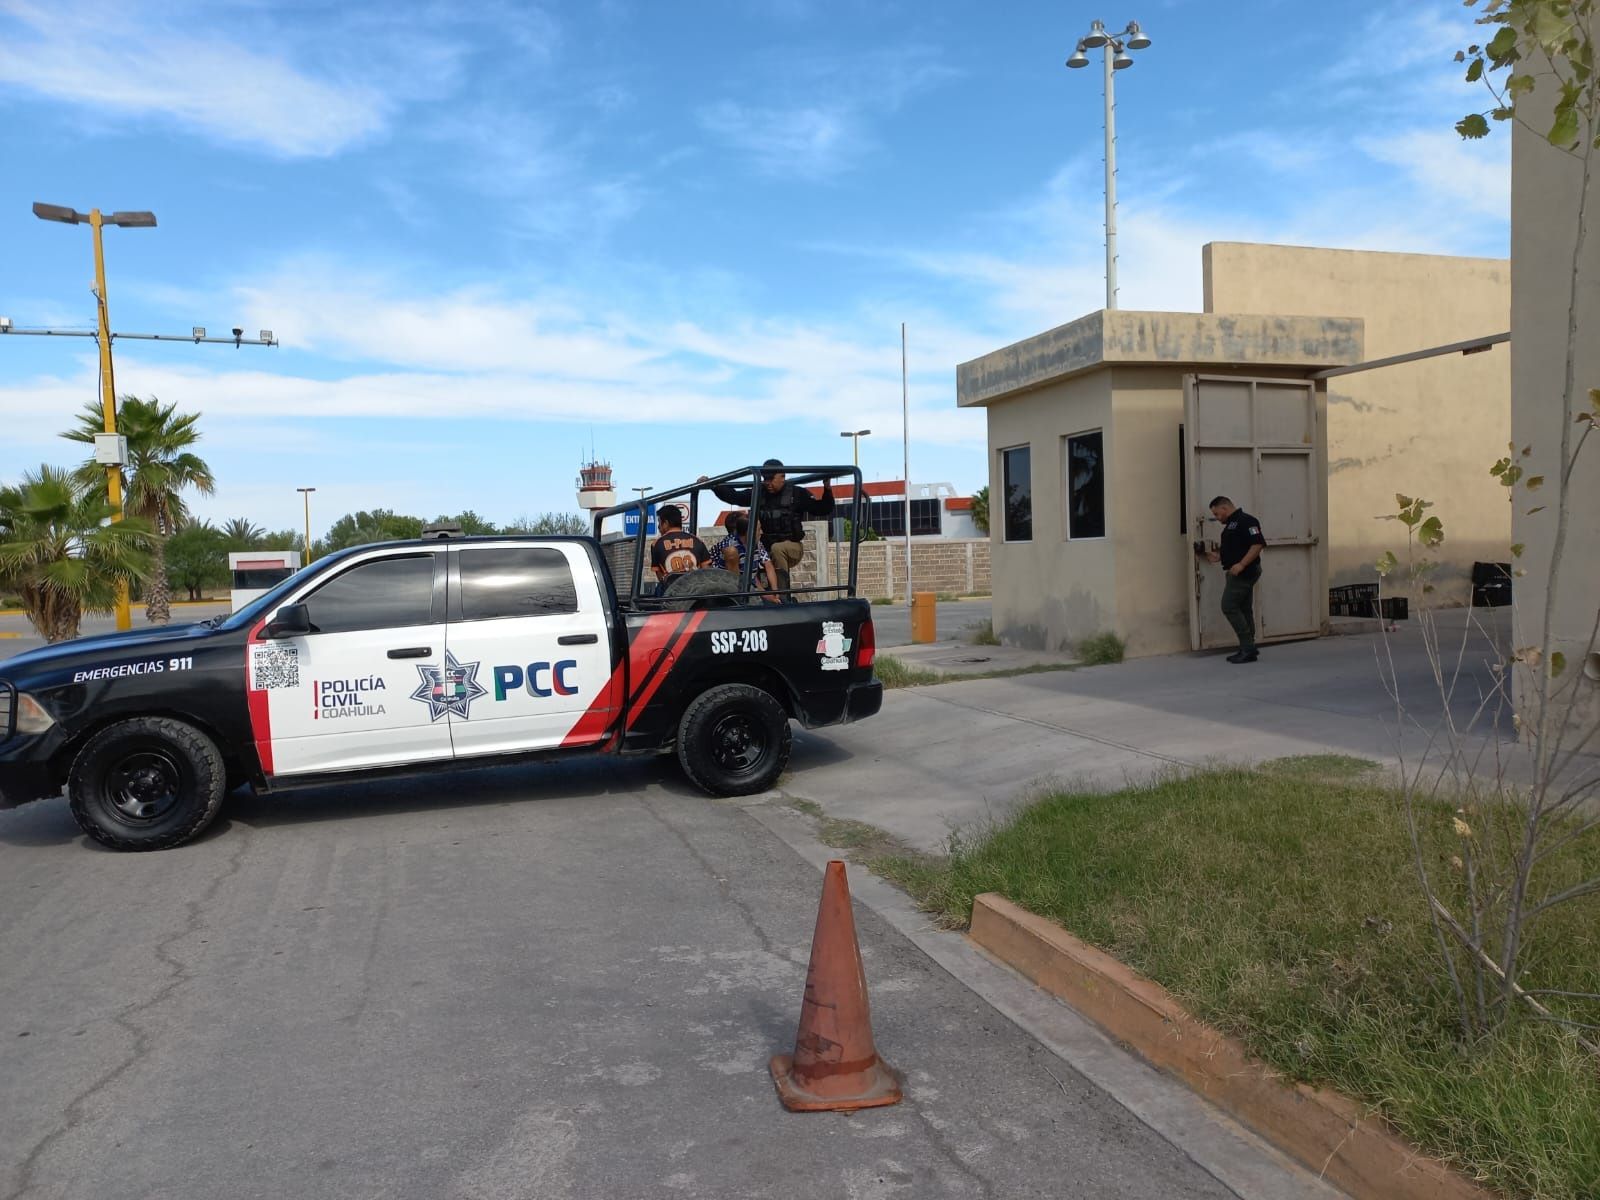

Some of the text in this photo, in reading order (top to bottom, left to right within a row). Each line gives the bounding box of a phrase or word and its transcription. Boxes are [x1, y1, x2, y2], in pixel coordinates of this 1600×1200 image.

[626, 515, 655, 524] ENTA
[711, 630, 768, 654] SSP-208
[73, 657, 193, 683] EMERGENCIAS 911
[321, 675, 386, 694] POLICÍA
[493, 659, 579, 701] PCC
[322, 693, 363, 708] CIVIL
[322, 704, 386, 719] COAHUILA
